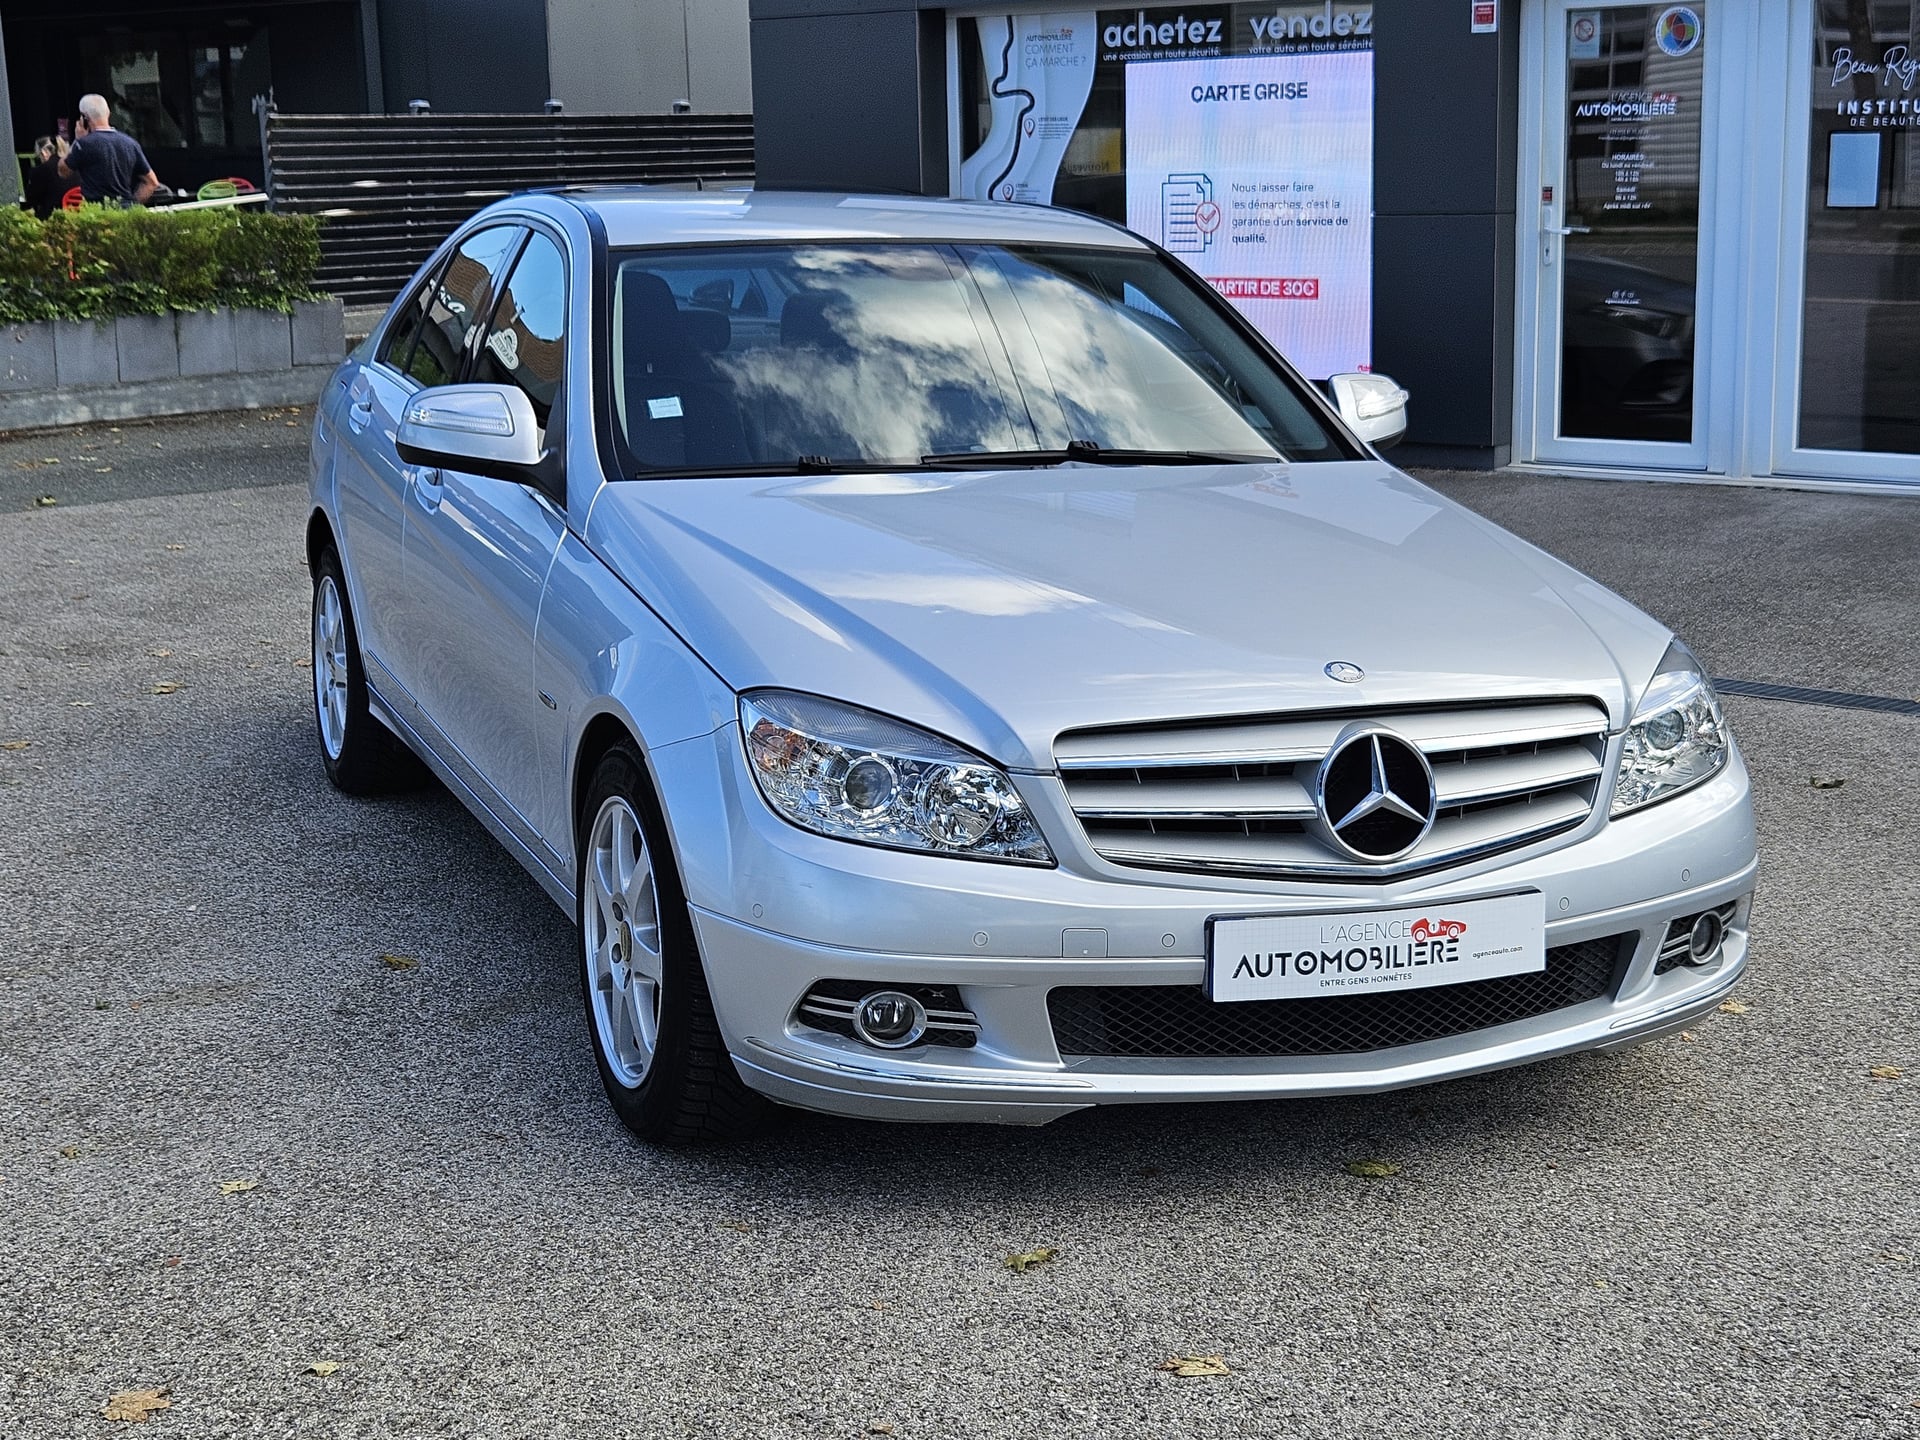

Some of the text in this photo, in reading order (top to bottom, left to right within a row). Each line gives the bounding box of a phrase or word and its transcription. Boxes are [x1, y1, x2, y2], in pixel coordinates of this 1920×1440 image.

[1249, 0, 1373, 39] vendez
[1104, 11, 1222, 47] achetez
[1025, 43, 1074, 54] COMMENT
[1119, 52, 1151, 60] occasion
[1165, 49, 1186, 58] toute
[1188, 47, 1221, 57] sécurité.
[1249, 45, 1272, 54] votre
[1273, 43, 1295, 53] auto
[1297, 43, 1308, 52] en
[1311, 42, 1335, 51] toute
[1025, 57, 1038, 69] ÇA
[1041, 56, 1079, 67] MARCHE
[1831, 45, 1920, 91] Beau Reg
[1191, 81, 1308, 103] CARTE GRISE
[1837, 100, 1920, 116] INSTITU
[1850, 117, 1867, 127] DE
[1231, 181, 1314, 193] Nous laisser faire
[1231, 199, 1246, 209] les
[1248, 199, 1304, 210] démarches,
[1331, 199, 1340, 209] la
[1231, 216, 1349, 230] garantie d'un service de
[1231, 233, 1267, 246] qualité.
[1260, 281, 1280, 296] DE
[1320, 972, 1412, 988] ENTRE GENS HONNÊTES
